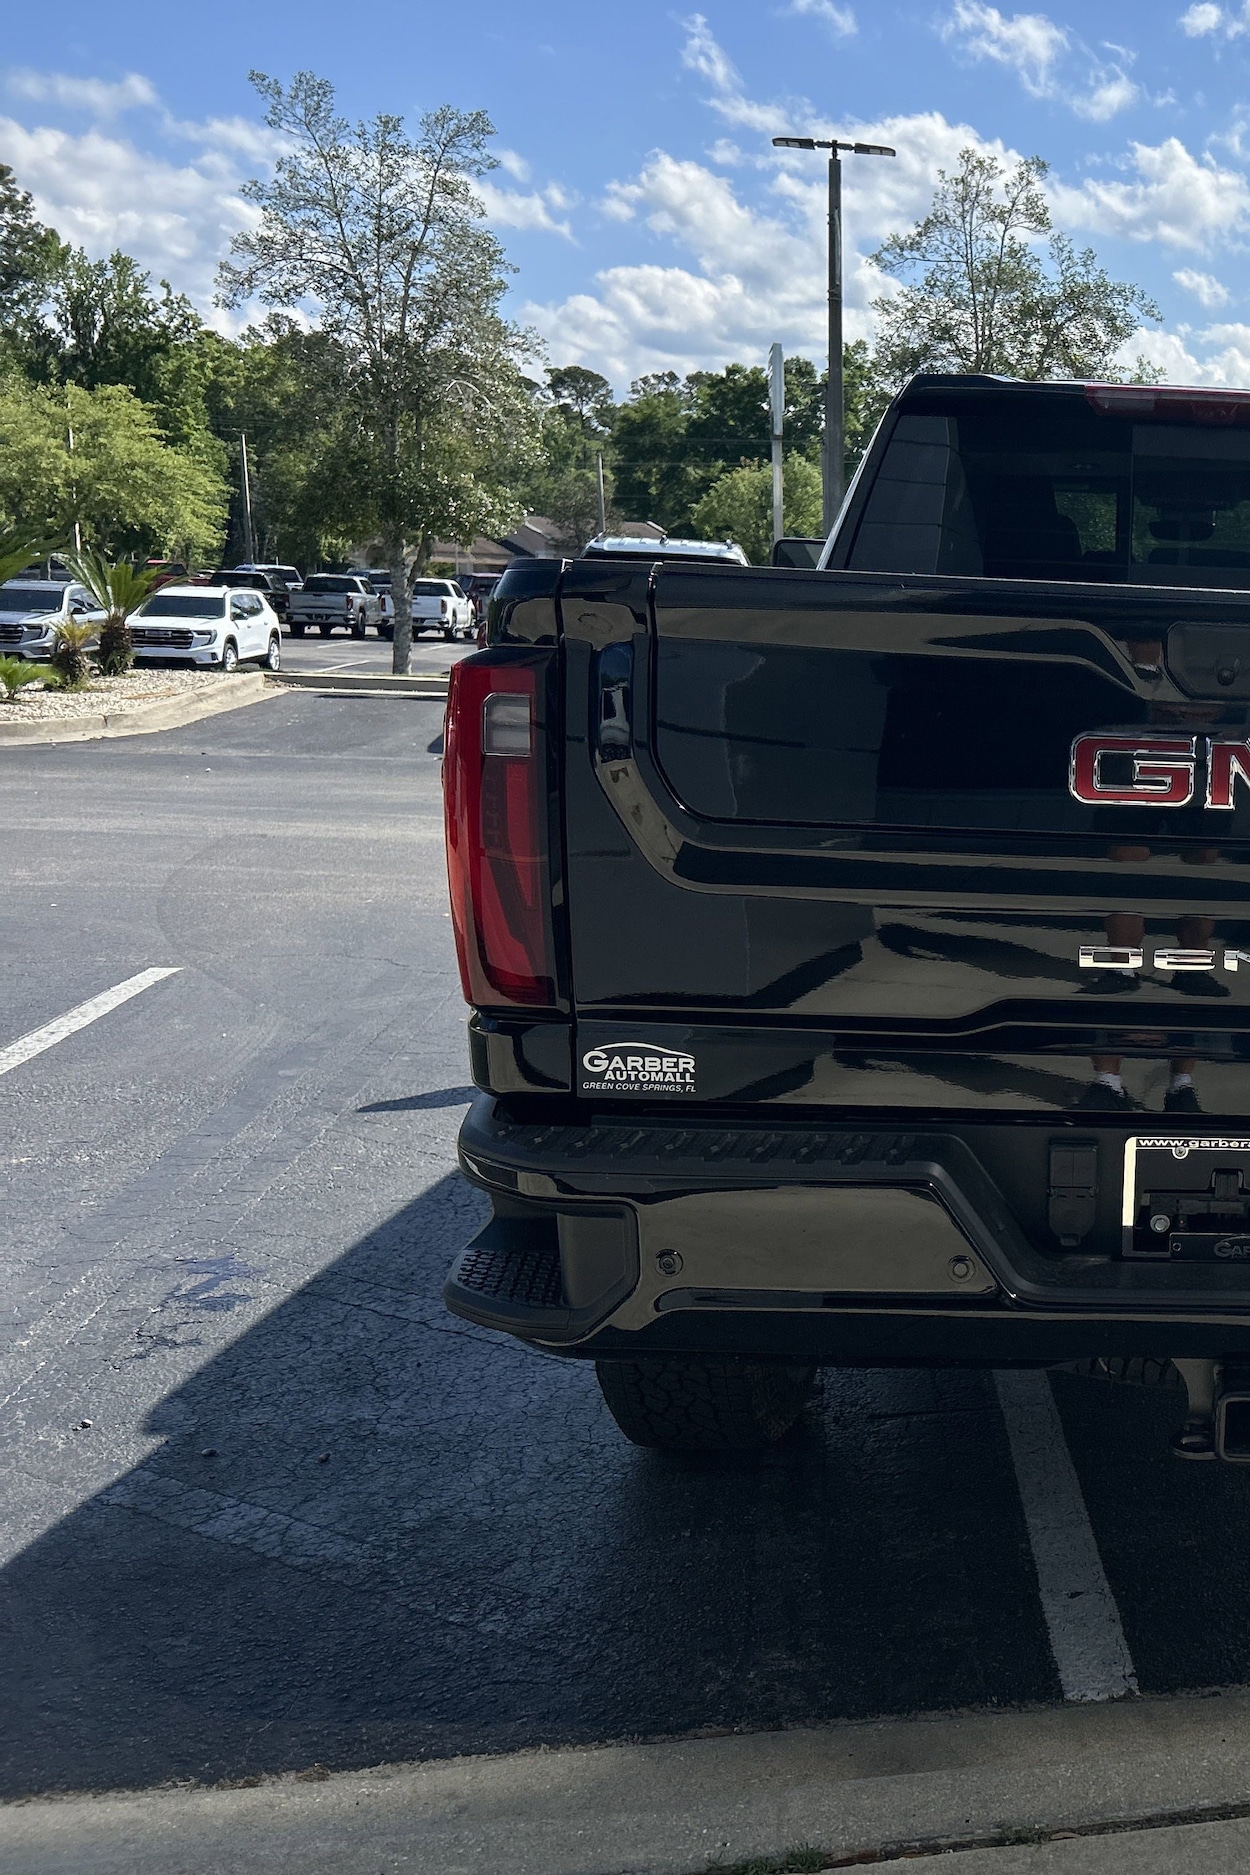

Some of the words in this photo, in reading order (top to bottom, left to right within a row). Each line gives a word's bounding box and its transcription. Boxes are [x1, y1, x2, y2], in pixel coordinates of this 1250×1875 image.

[582, 1050, 696, 1073] GARBER
[604, 1071, 695, 1083] AUTOMALL
[582, 1082, 616, 1090] GREEN
[615, 1083, 641, 1091] COVE
[642, 1083, 684, 1093] SPRINGS,
